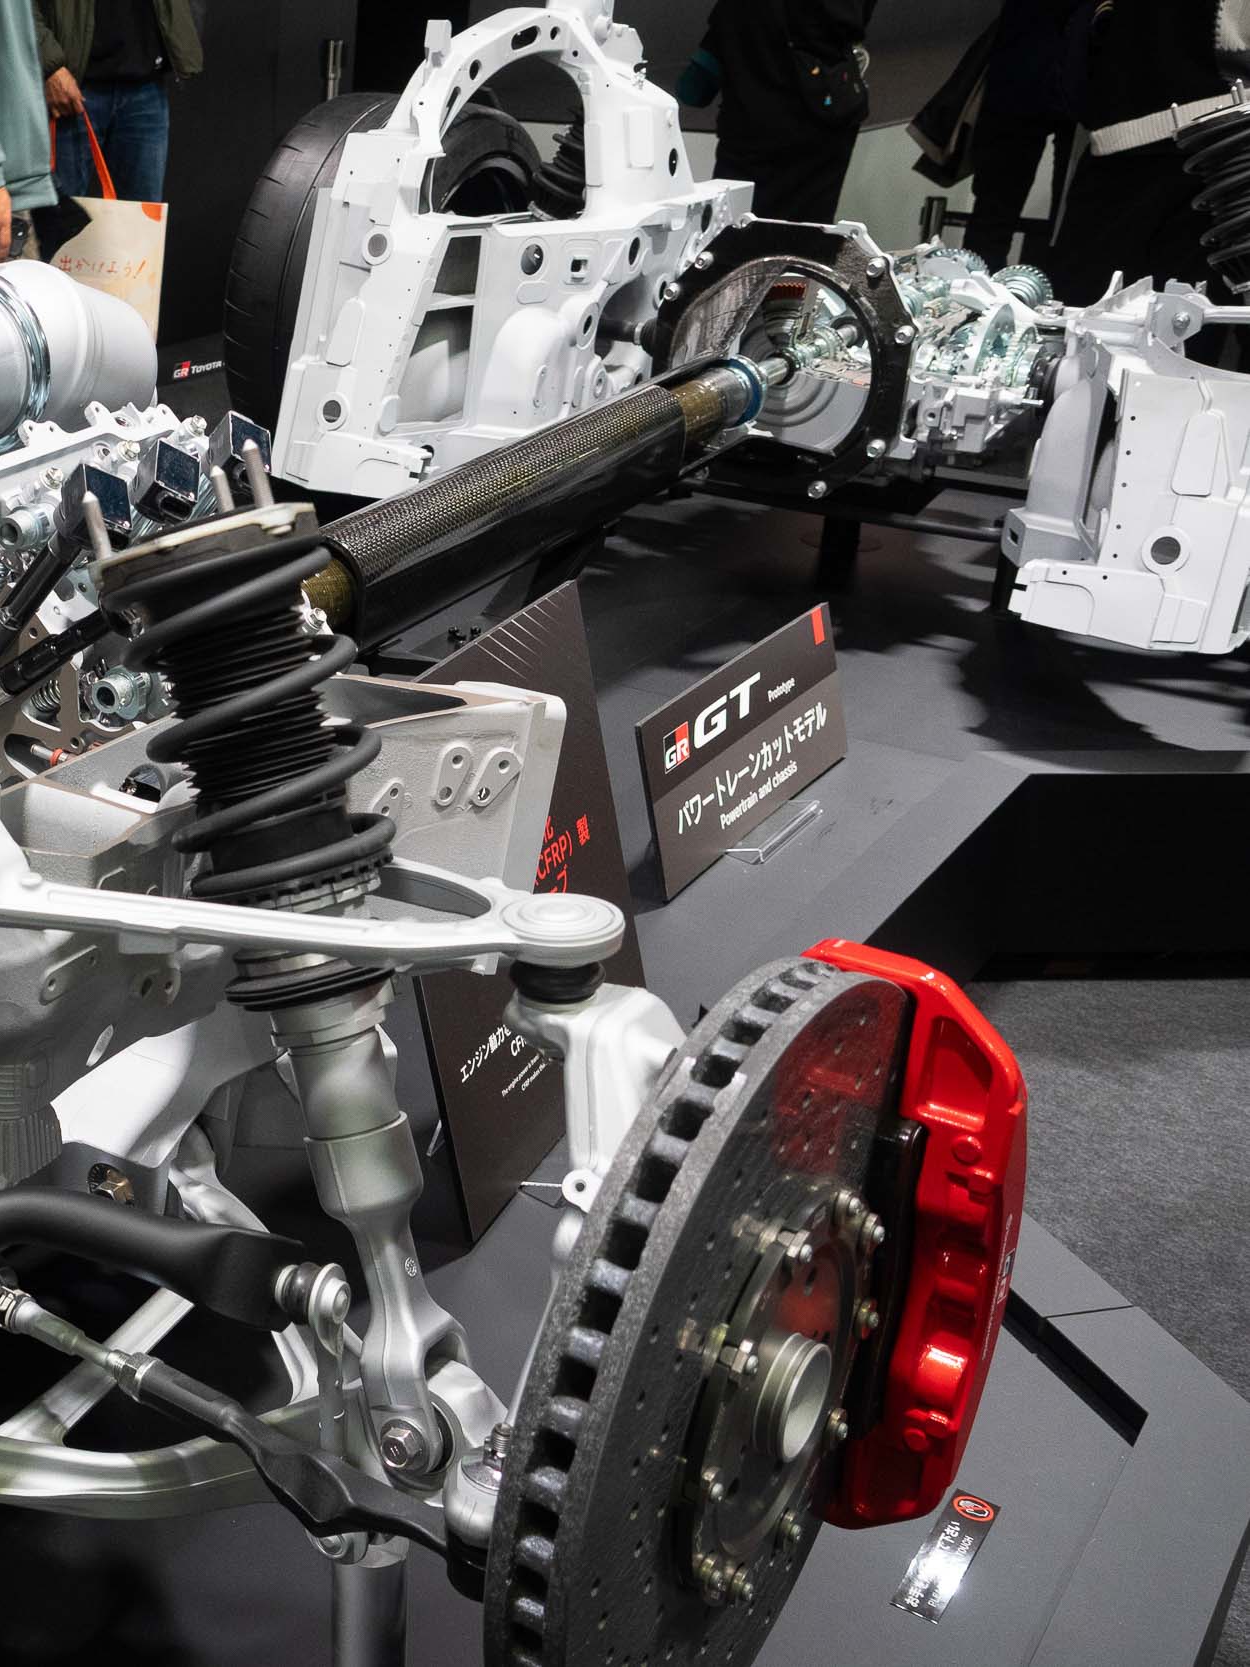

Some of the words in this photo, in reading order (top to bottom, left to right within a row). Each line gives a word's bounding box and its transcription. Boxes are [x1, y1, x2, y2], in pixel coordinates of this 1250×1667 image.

[173, 366, 190, 379] GR
[191, 360, 222, 375] TOYOTA
[664, 738, 690, 773] GR
[694, 671, 761, 750] GT
[767, 677, 795, 703] Prototype
[677, 701, 828, 835] パワートレーンカットモデル
[720, 790, 759, 830] Powertrain
[758, 778, 773, 799] and
[772, 760, 798, 788] chassis
